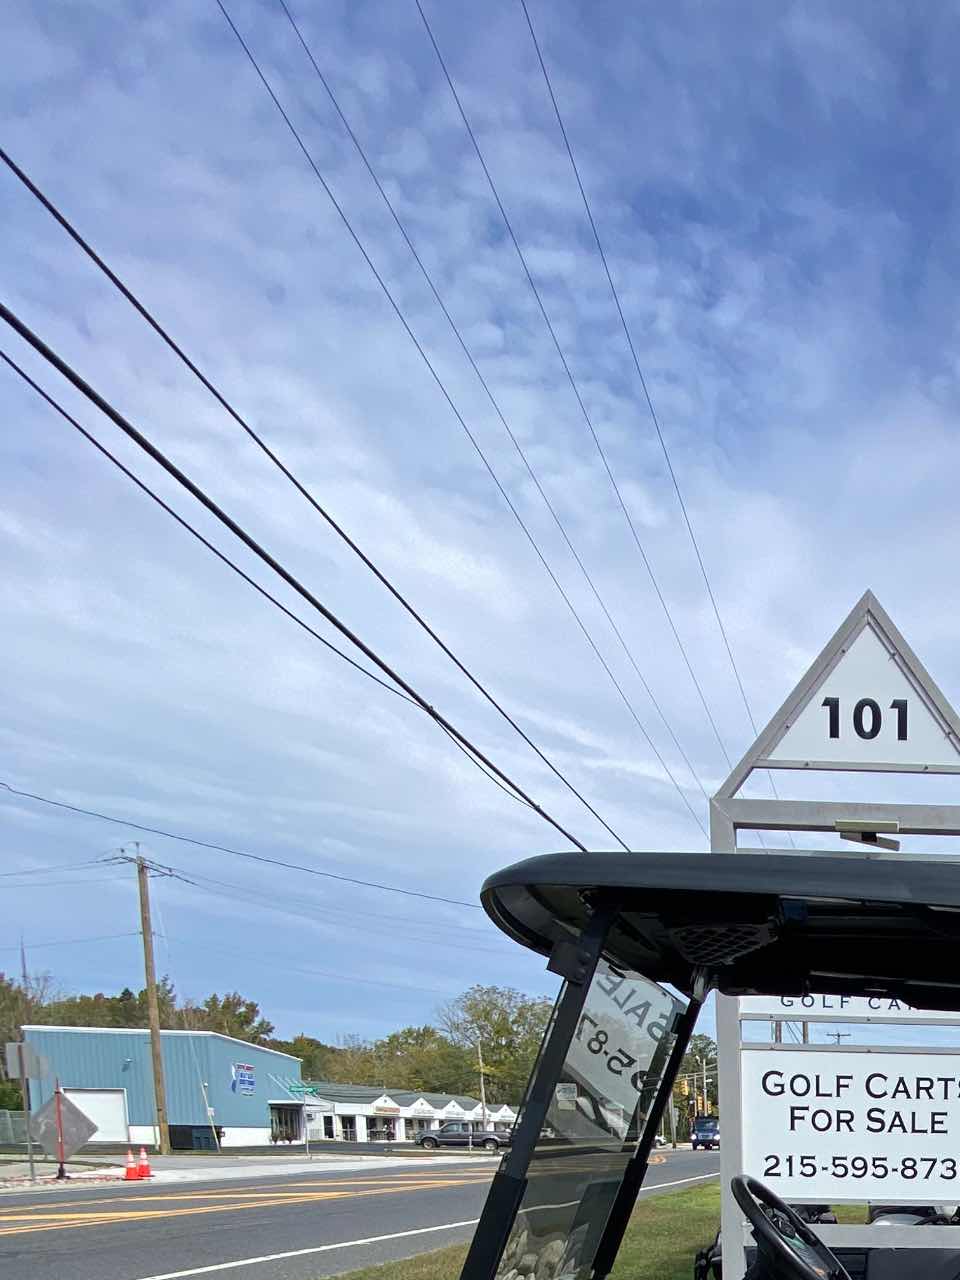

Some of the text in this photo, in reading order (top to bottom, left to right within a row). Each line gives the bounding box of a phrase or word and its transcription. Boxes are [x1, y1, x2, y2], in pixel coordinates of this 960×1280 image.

[821, 696, 908, 741] 101
[780, 995, 914, 1010] GOLF CA
[761, 1070, 854, 1098] GOLF
[789, 1106, 949, 1134] FOR SALE
